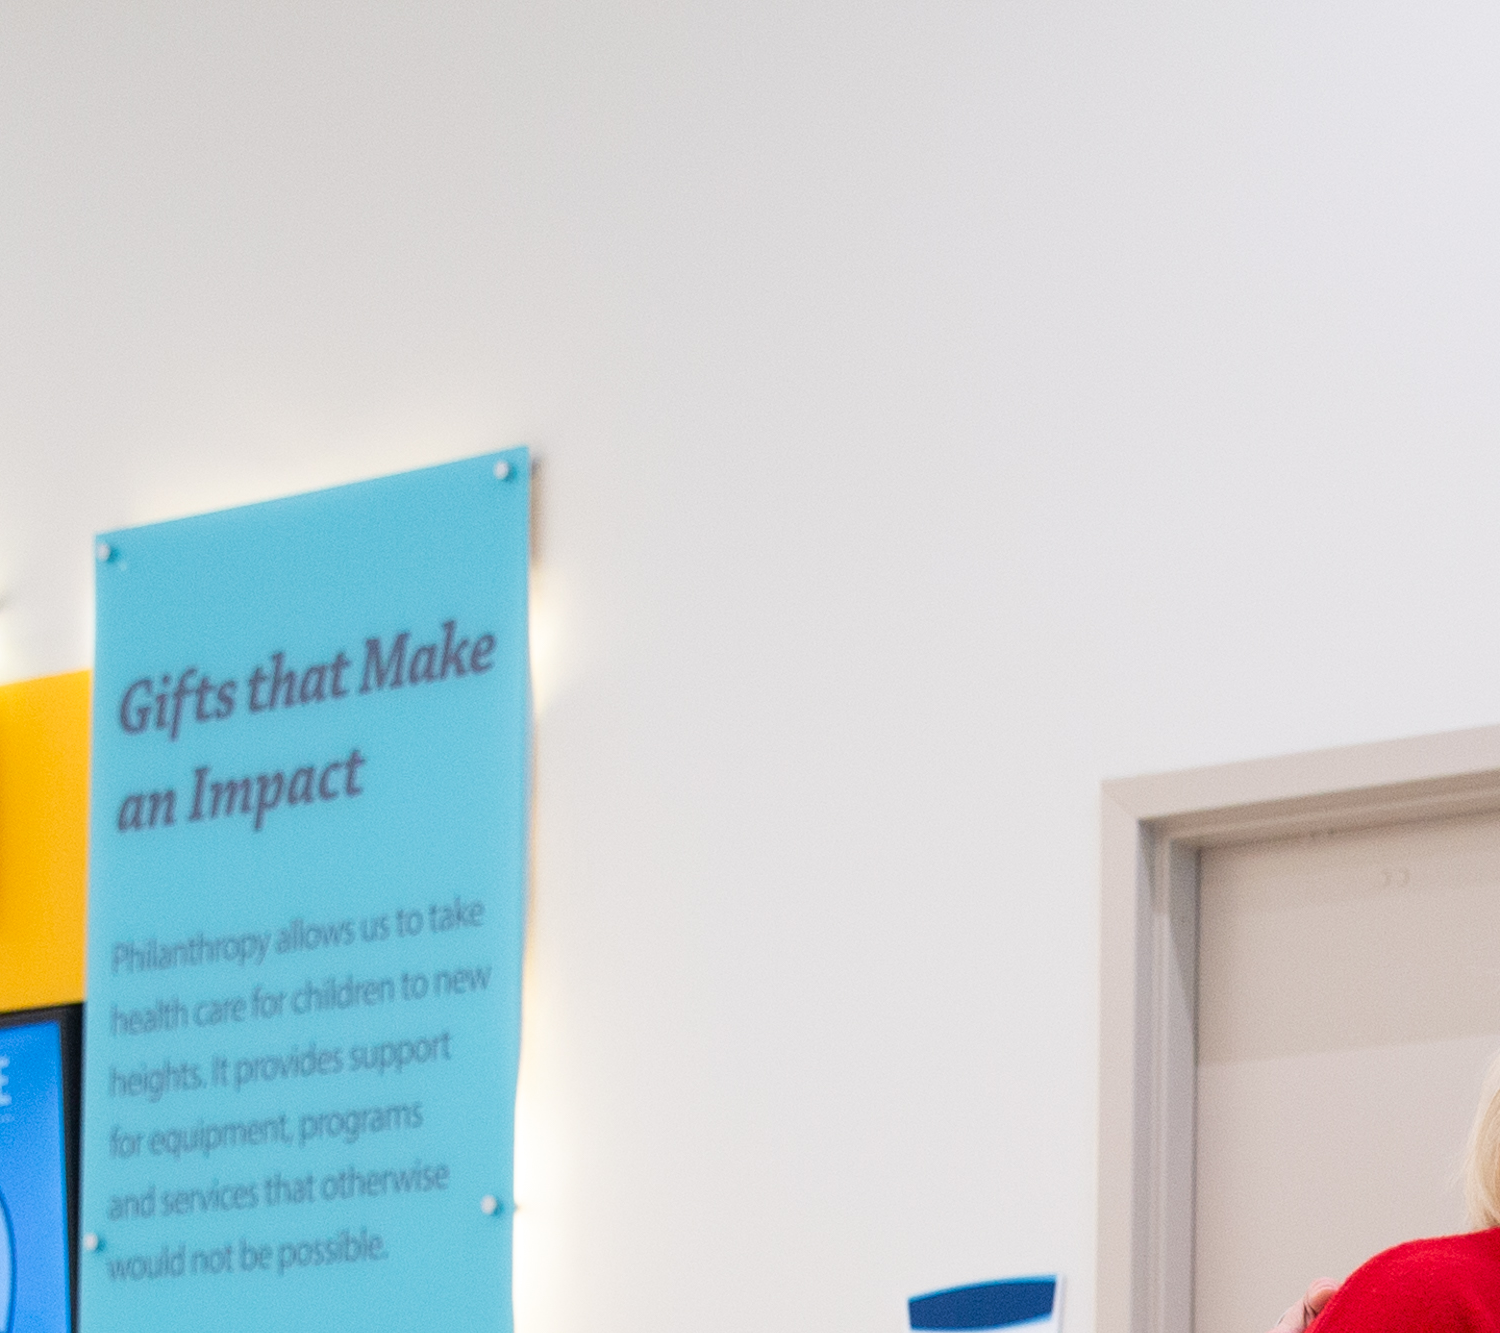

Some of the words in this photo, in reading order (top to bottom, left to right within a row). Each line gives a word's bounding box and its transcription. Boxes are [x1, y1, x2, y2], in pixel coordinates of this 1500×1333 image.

[118, 667, 237, 742] Gifts
[248, 651, 352, 713] that
[359, 619, 497, 695] Make
[117, 788, 177, 832] an
[188, 749, 366, 832] Impact
[110, 930, 271, 976] Philanthropy
[275, 917, 357, 954] allows
[359, 912, 390, 942] us
[397, 906, 424, 937] to
[429, 895, 486, 933] take
[110, 997, 189, 1036] health
[193, 997, 247, 1029] care
[250, 986, 288, 1022] for
[290, 975, 395, 1015] children
[401, 971, 429, 1002] to
[434, 963, 492, 996] new
[109, 1059, 208, 1103] heights.
[212, 1055, 228, 1088] It
[233, 1043, 344, 1092] provides
[348, 1031, 453, 1077] support
[109, 1124, 145, 1160] for
[299, 1102, 425, 1147] programs
[108, 1185, 156, 1222] and
[162, 1177, 260, 1213] services
[262, 1171, 316, 1206] that
[320, 1158, 451, 1200] otherwise
[106, 1244, 187, 1282] would
[190, 1242, 233, 1276] not
[239, 1238, 273, 1273] be
[277, 1227, 390, 1277] possible.
